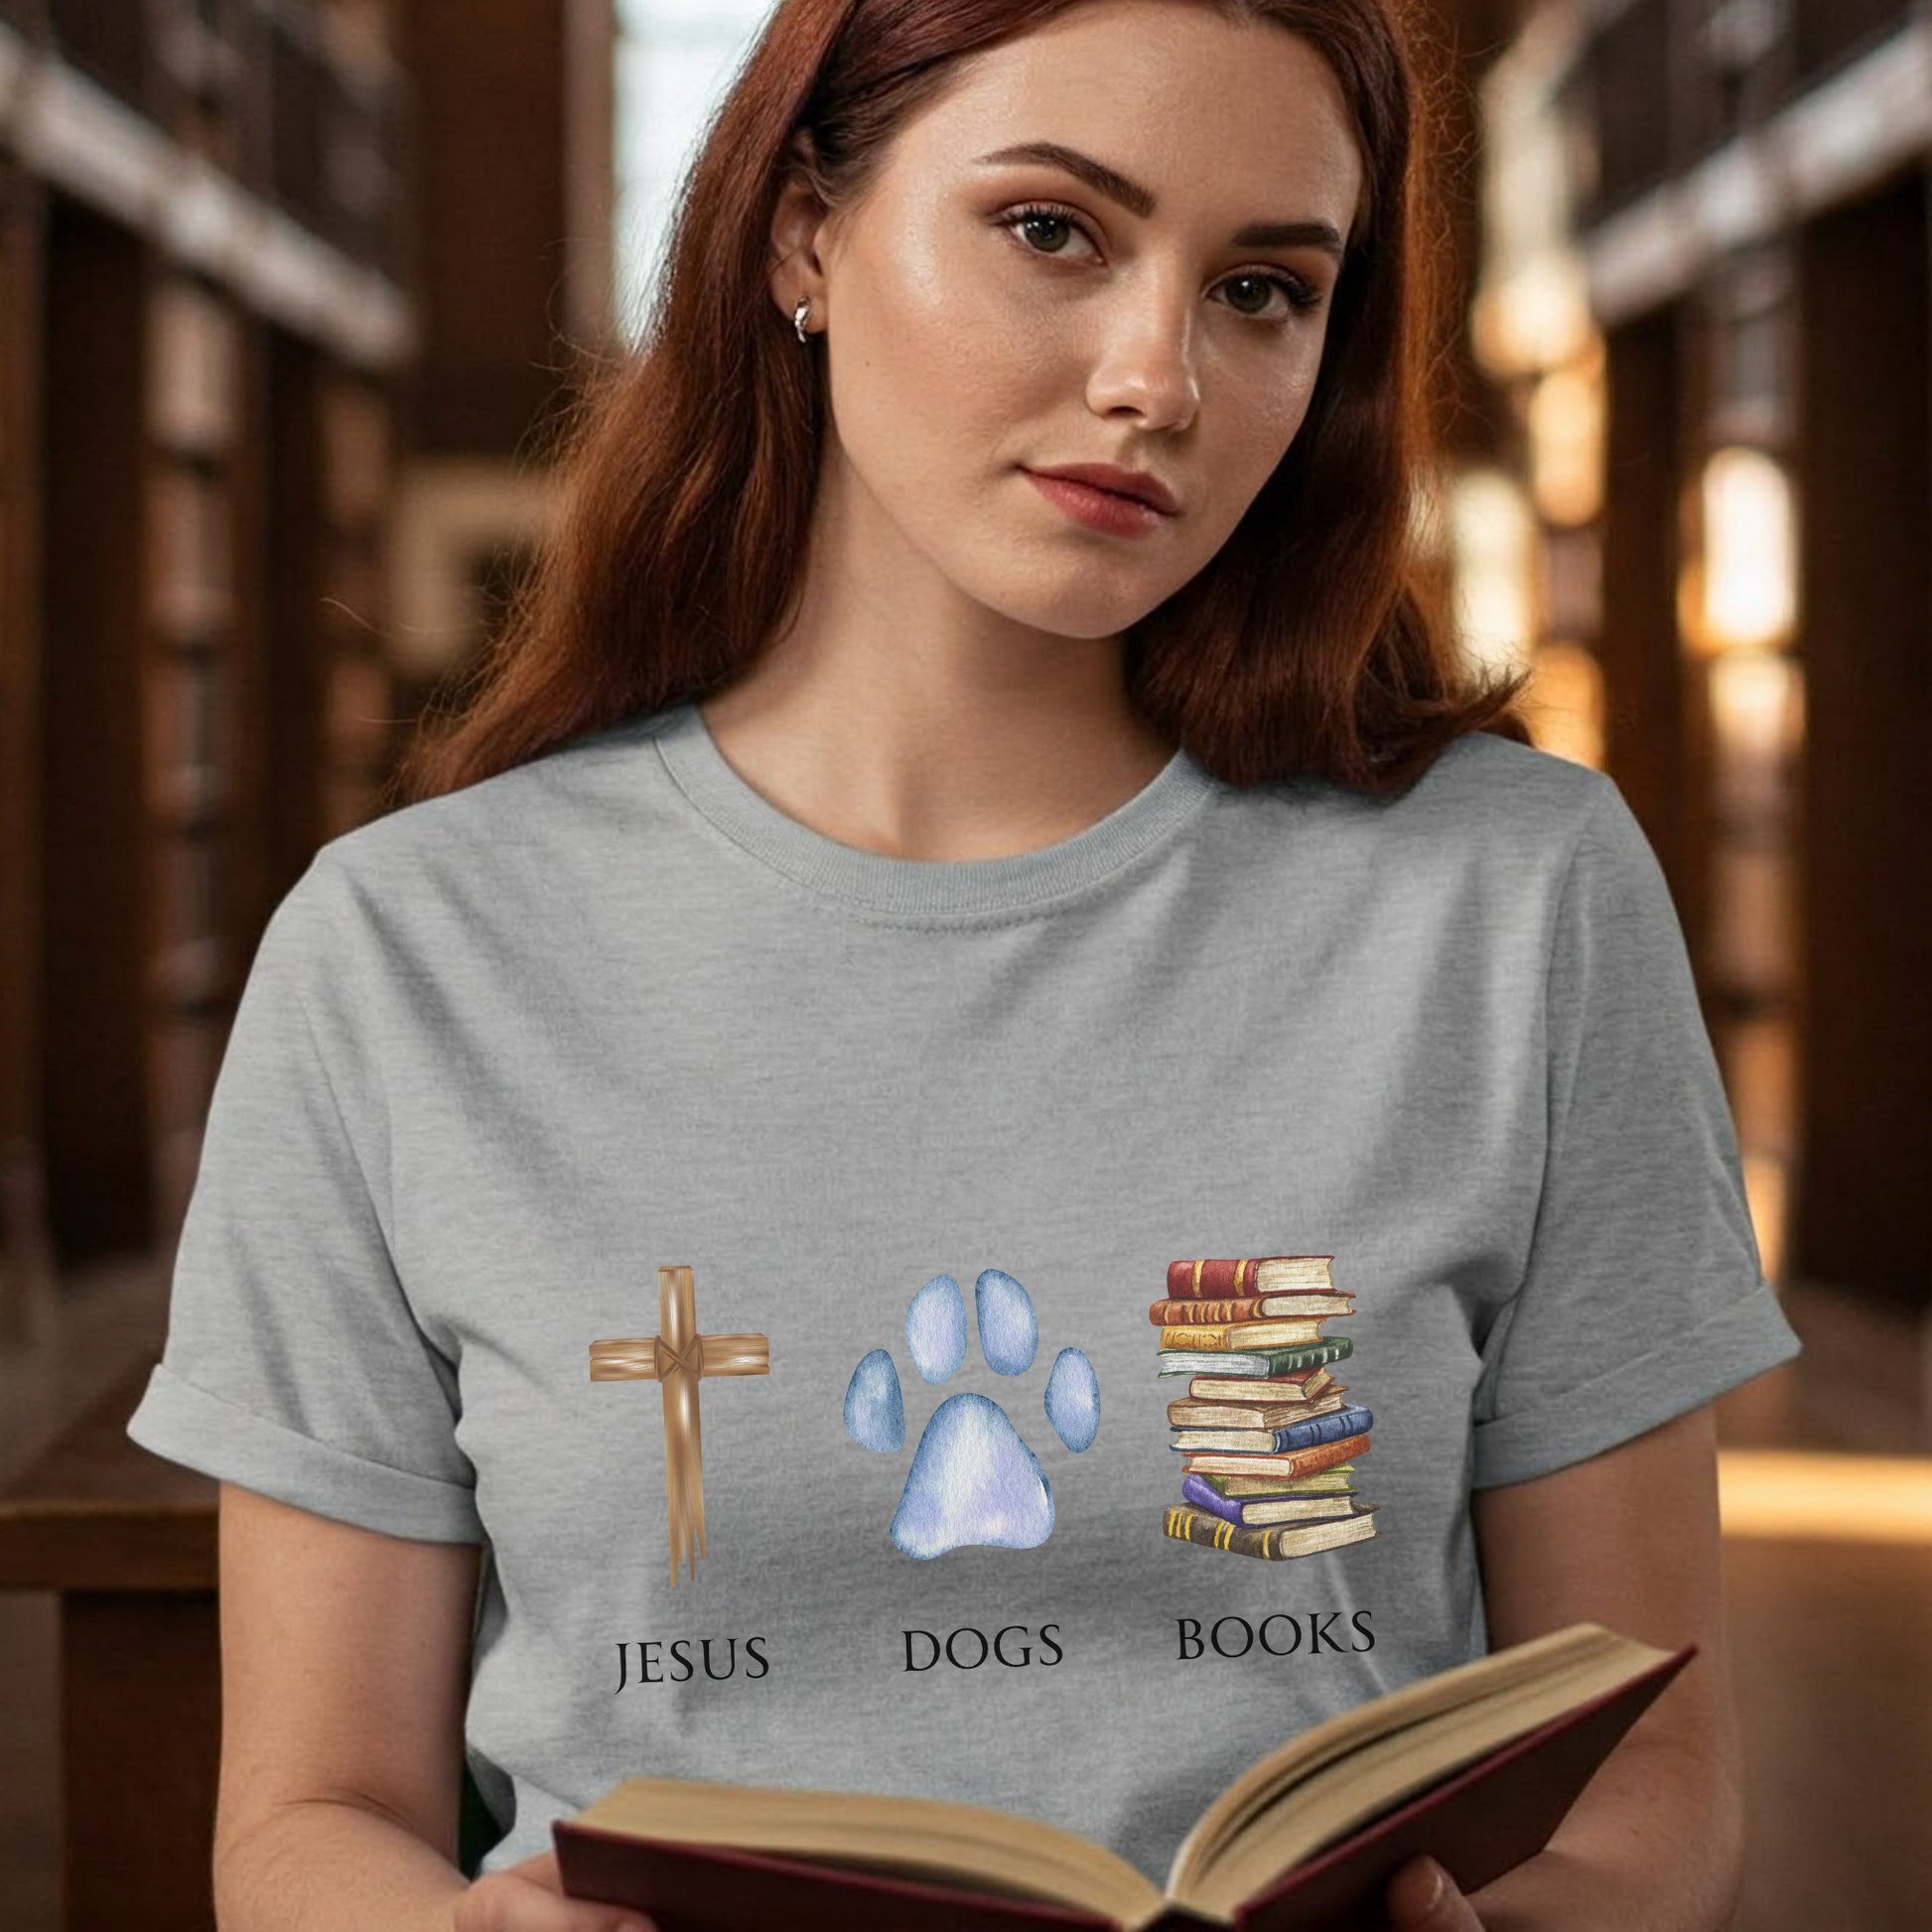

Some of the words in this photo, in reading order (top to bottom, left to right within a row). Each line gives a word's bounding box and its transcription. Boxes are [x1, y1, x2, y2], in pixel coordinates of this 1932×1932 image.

[615, 1636, 769, 1696] JESUS
[900, 1623, 1063, 1672] DOGS
[1173, 1608, 1376, 1661] BOOKS
